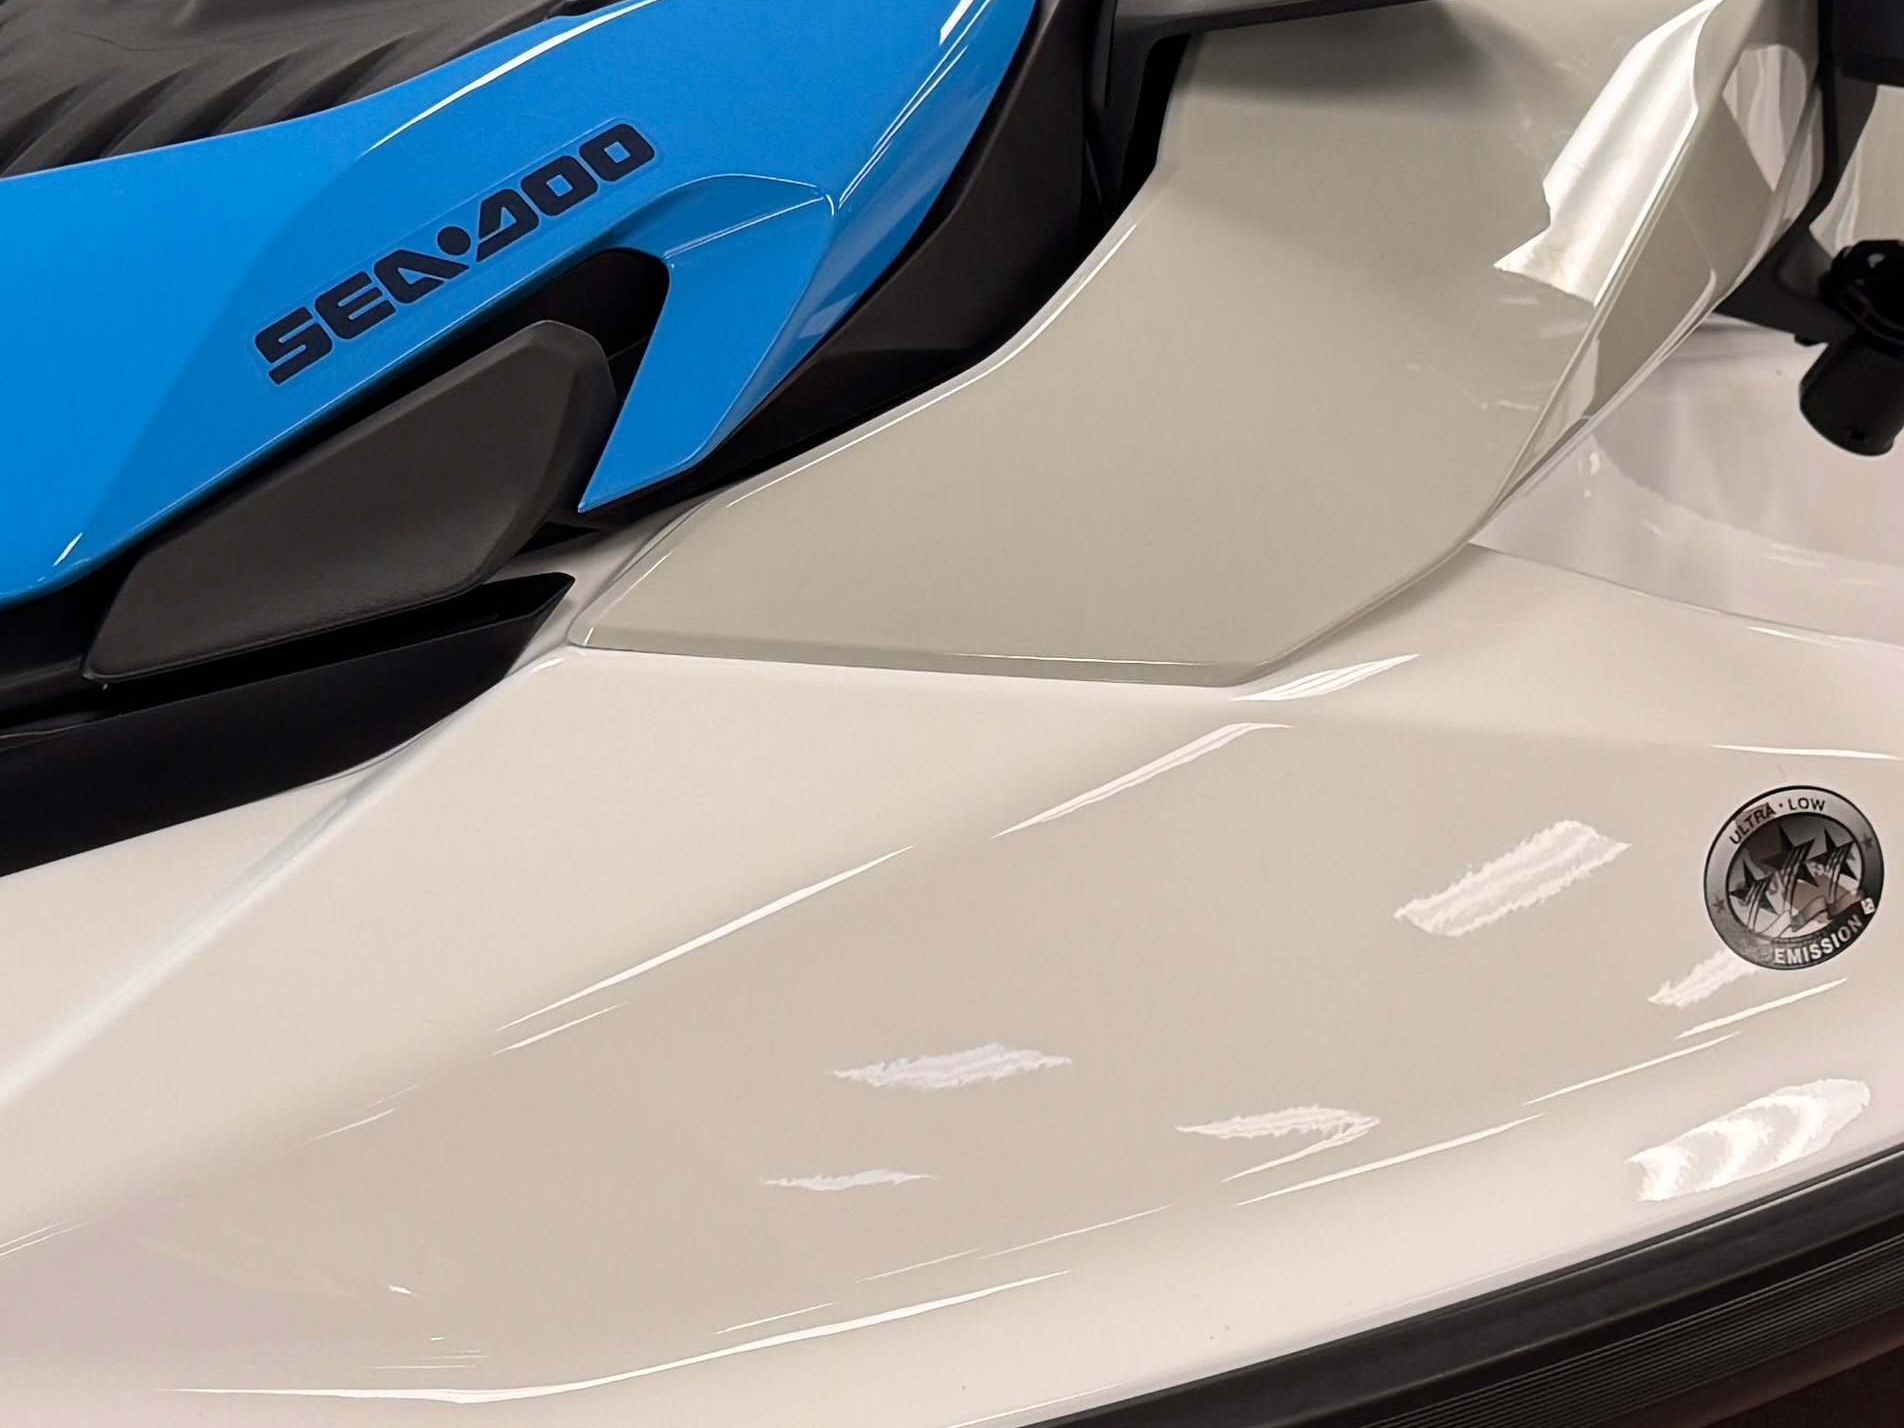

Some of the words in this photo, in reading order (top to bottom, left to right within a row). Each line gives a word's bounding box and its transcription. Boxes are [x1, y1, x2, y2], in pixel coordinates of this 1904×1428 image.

[1729, 801, 1777, 846] ULTRA
[1788, 797, 1826, 812] LOW
[1774, 914, 1863, 965] EMISSION
